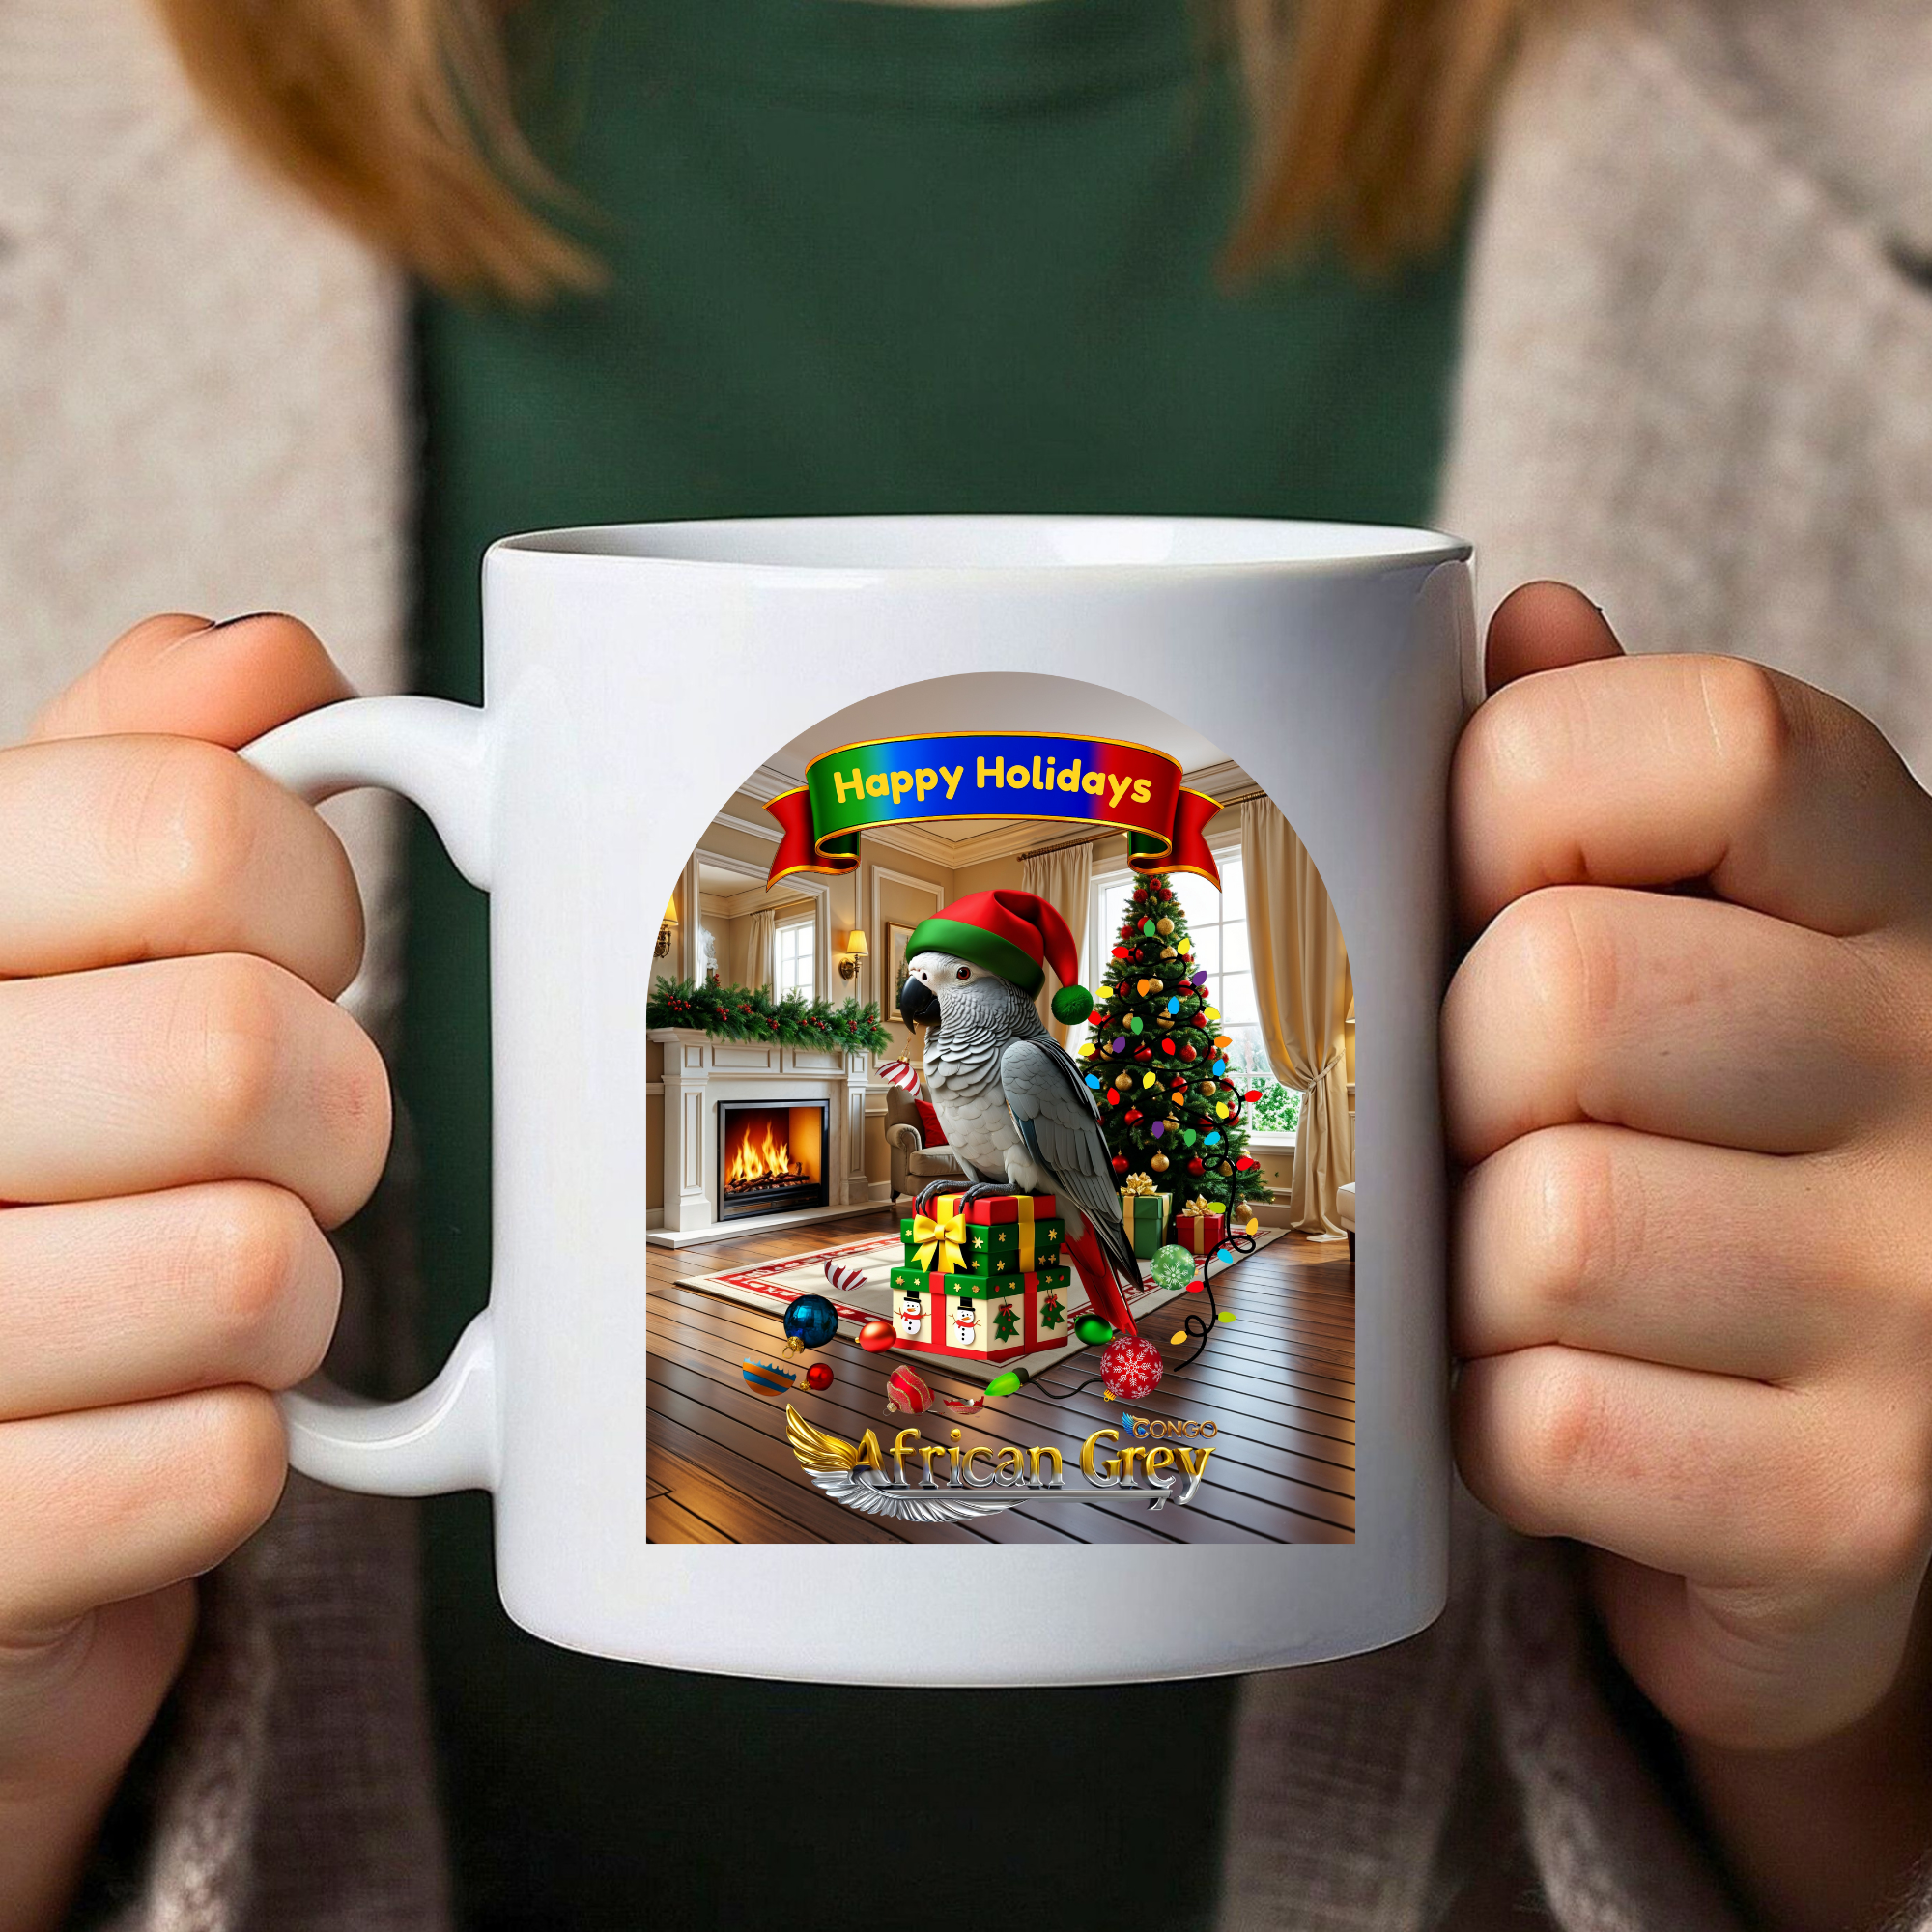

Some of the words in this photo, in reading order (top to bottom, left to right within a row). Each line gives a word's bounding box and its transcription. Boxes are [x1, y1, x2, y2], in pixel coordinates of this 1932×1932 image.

[833, 765, 964, 805] Happy
[976, 754, 1152, 808] Holidays
[1131, 1419, 1218, 1440] CONGO
[847, 1428, 1065, 1489] African
[1079, 1428, 1216, 1506] Grey
